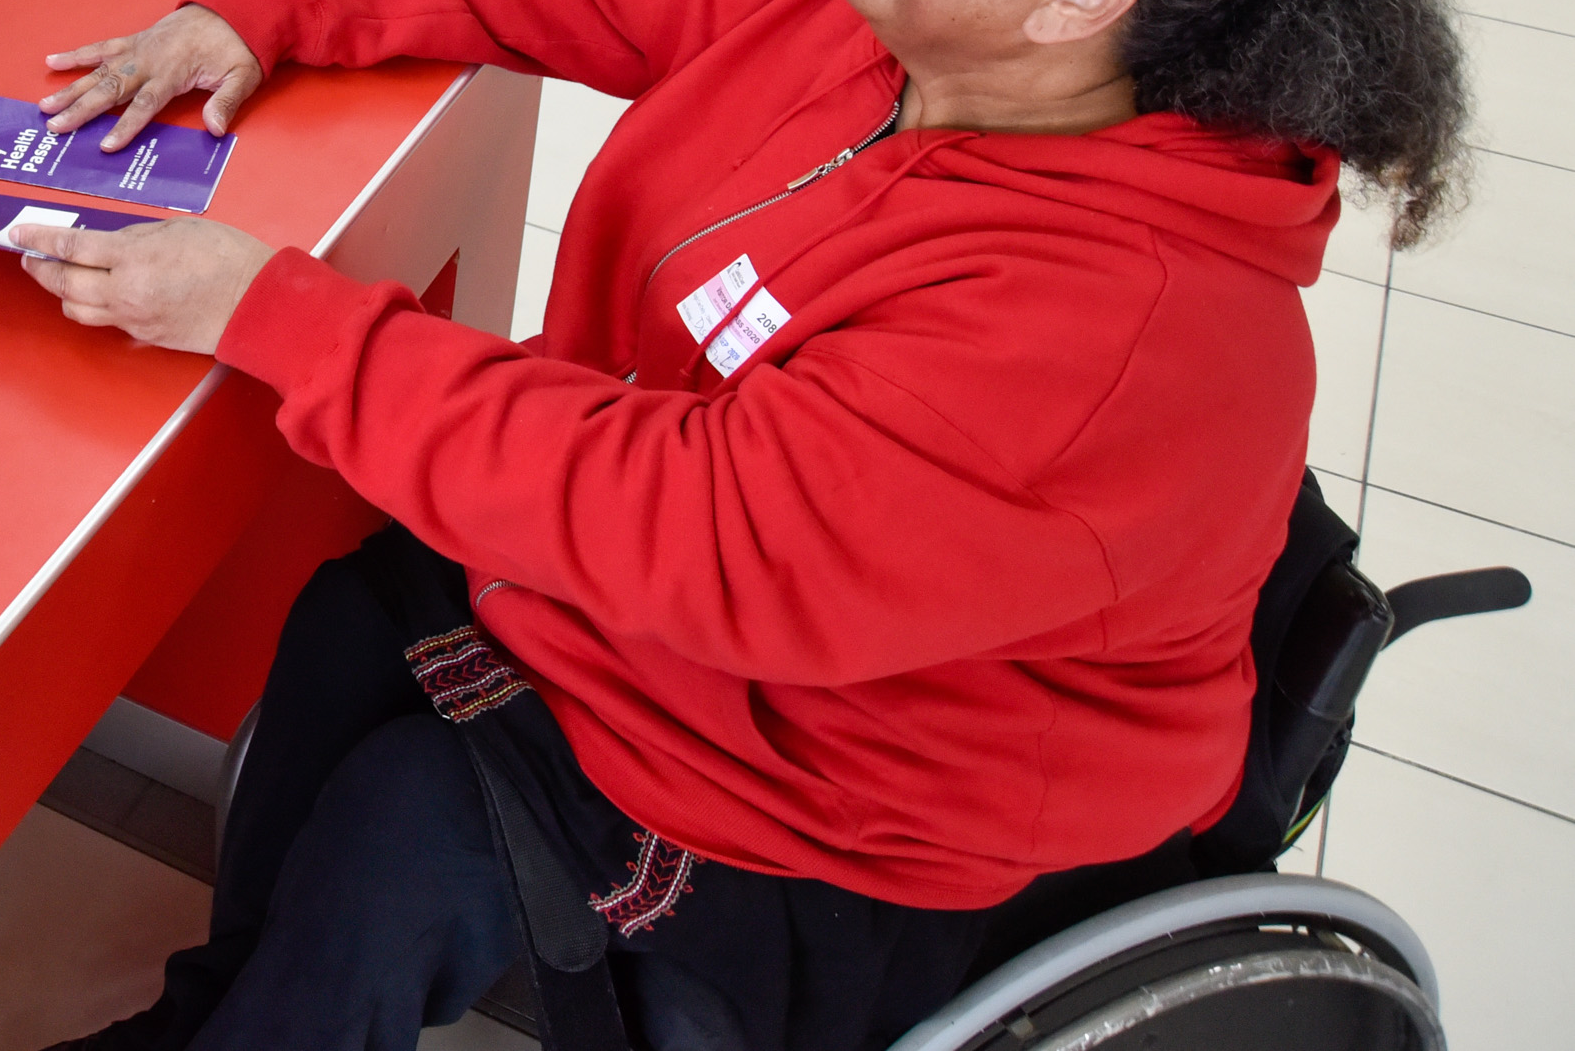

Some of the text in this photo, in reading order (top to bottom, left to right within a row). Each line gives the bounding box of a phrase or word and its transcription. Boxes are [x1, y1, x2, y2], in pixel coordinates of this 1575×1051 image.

[0, 128, 39, 169] Health
[21, 128, 60, 173] Passpo
[118, 171, 131, 188] Please
[136, 145, 146, 155] take
[127, 138, 159, 189] My Health Passport with
[136, 182, 144, 190] me
[140, 169, 151, 181] when
[716, 287, 727, 306] VISITOR
[743, 326, 761, 345] 2020
[757, 313, 778, 335] 208
